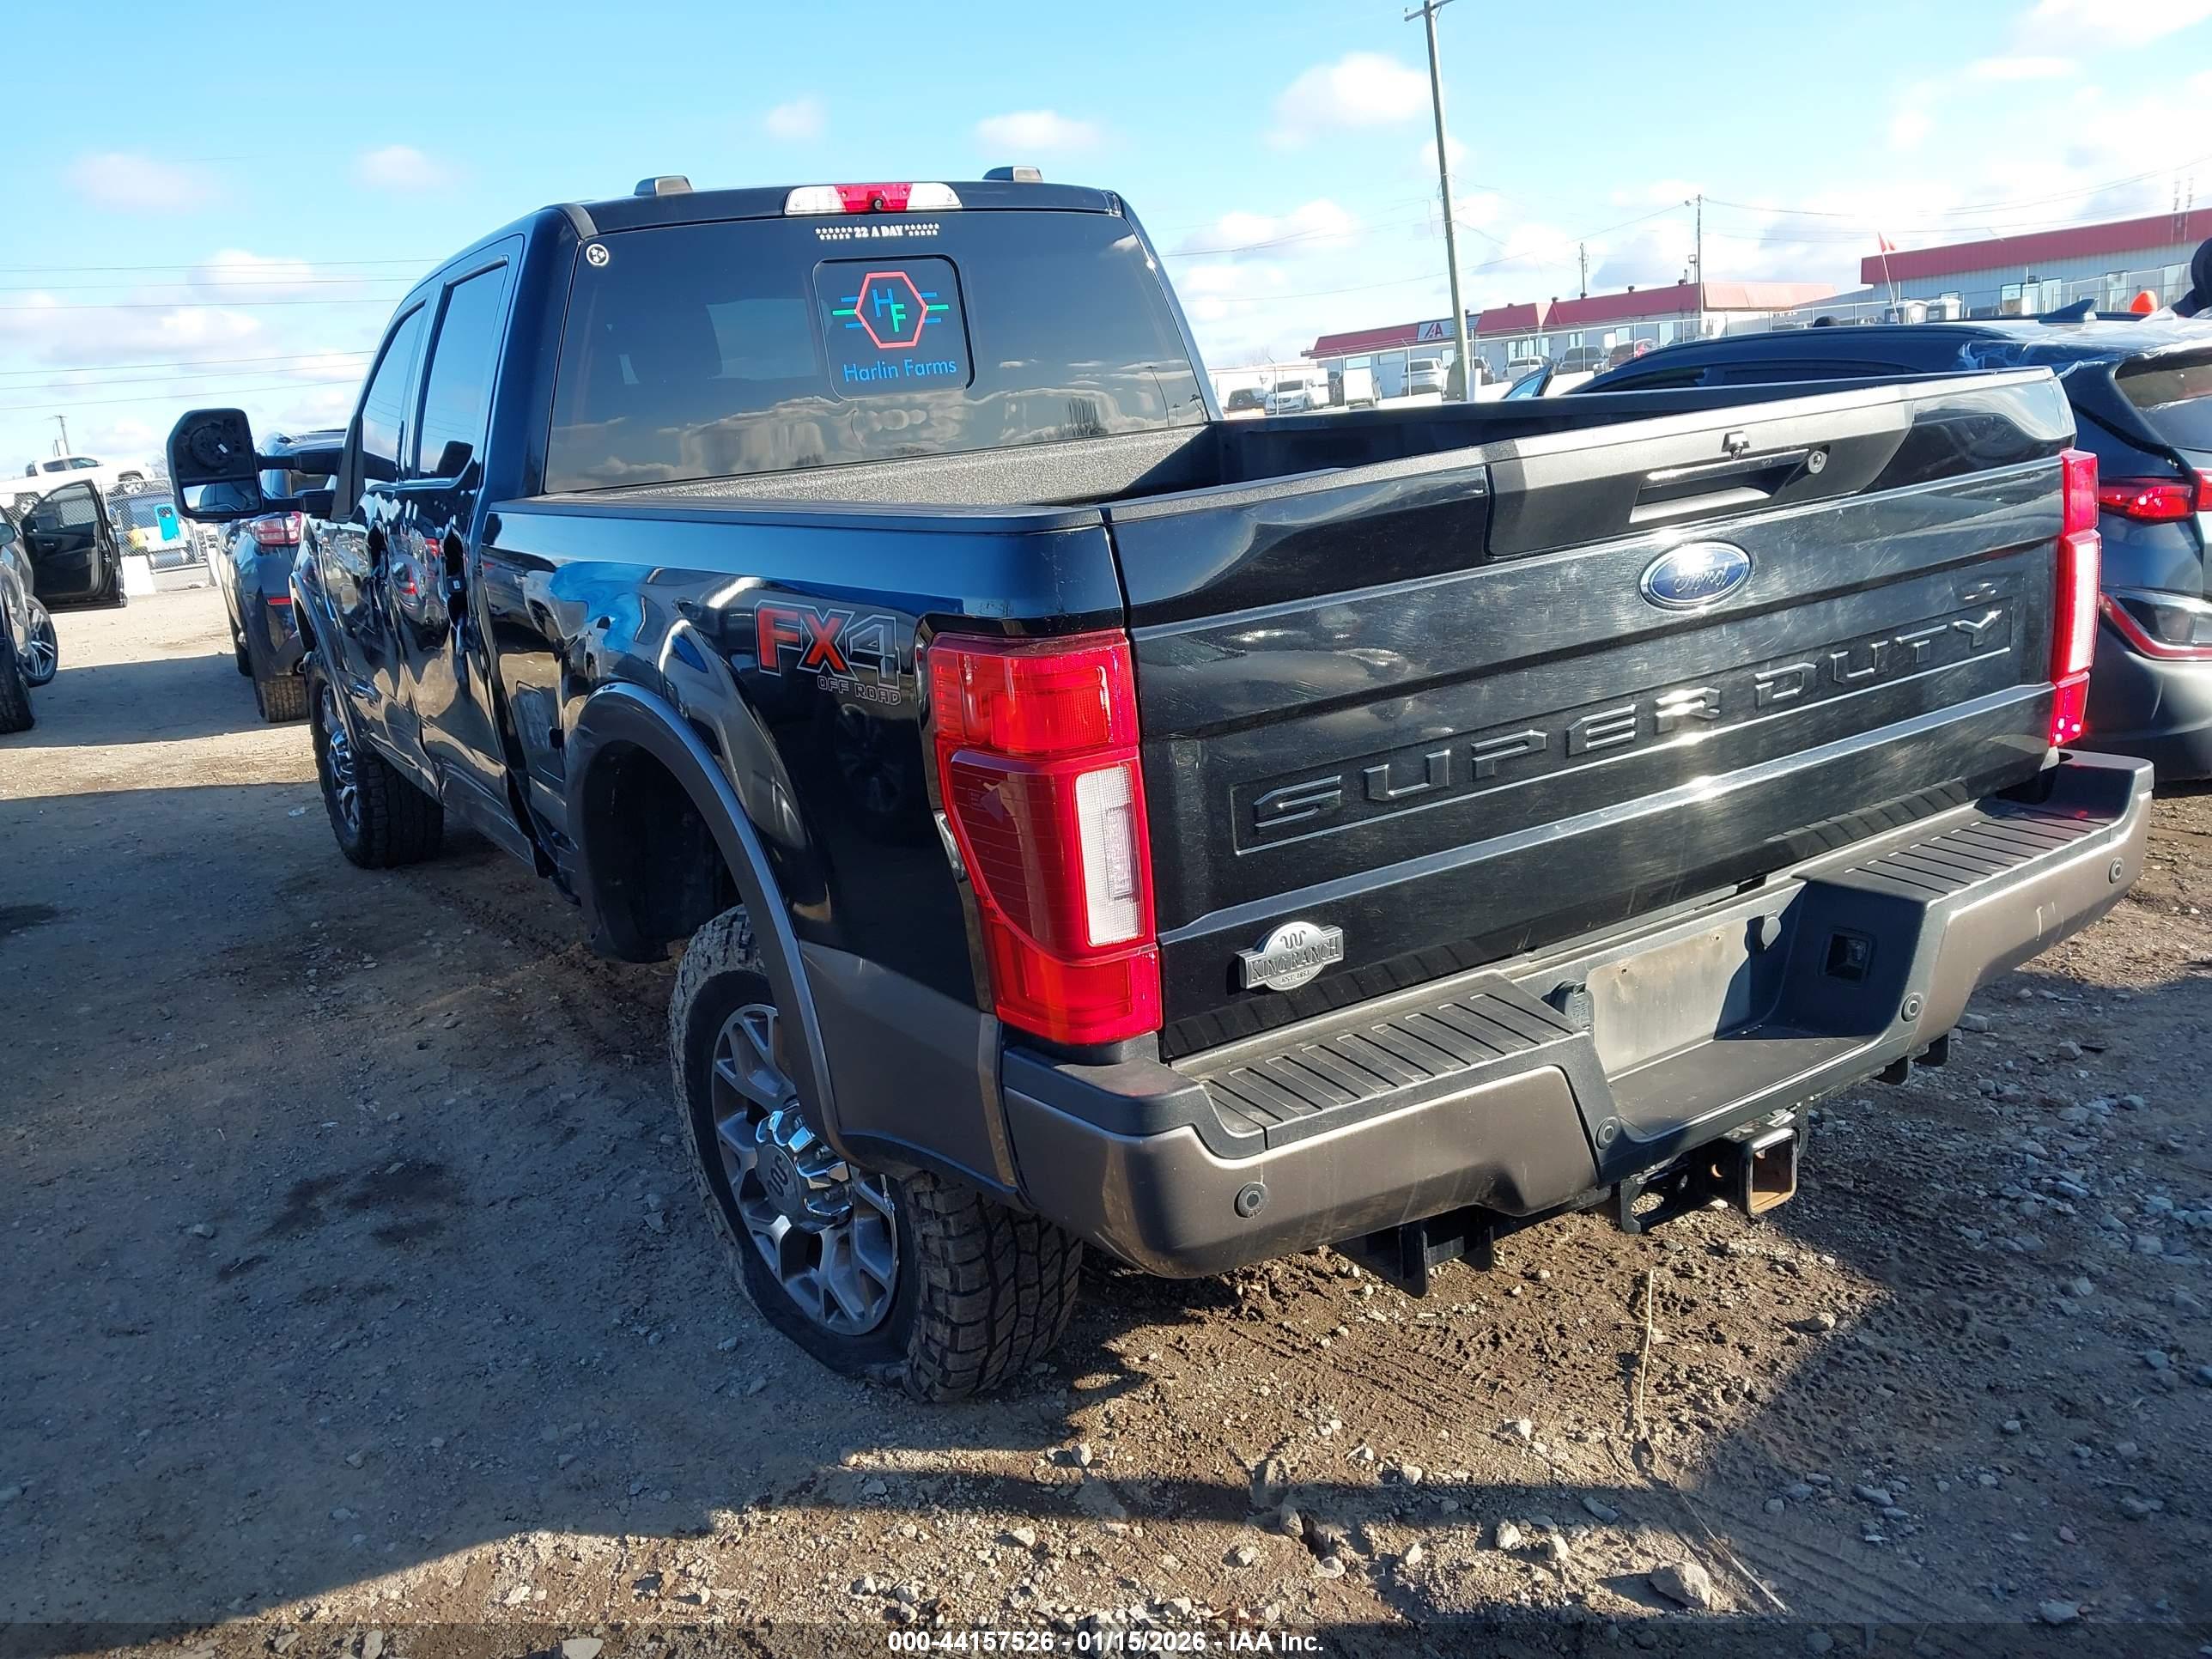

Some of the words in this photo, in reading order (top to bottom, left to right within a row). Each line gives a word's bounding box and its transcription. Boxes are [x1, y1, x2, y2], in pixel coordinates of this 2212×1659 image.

[854, 227, 869, 238] 22
[871, 225, 880, 237] A
[880, 225, 903, 237] DAY
[843, 360, 899, 382] Harlin
[903, 357, 957, 377] Farms
[755, 599, 901, 690] FX4
[817, 675, 849, 694] OFF
[854, 682, 902, 706] ROAD
[1253, 685, 1722, 830] SUPER
[1754, 609, 2002, 708] DUTY
[1249, 955, 1288, 981] KING
[1291, 936, 1340, 969] RANCH
